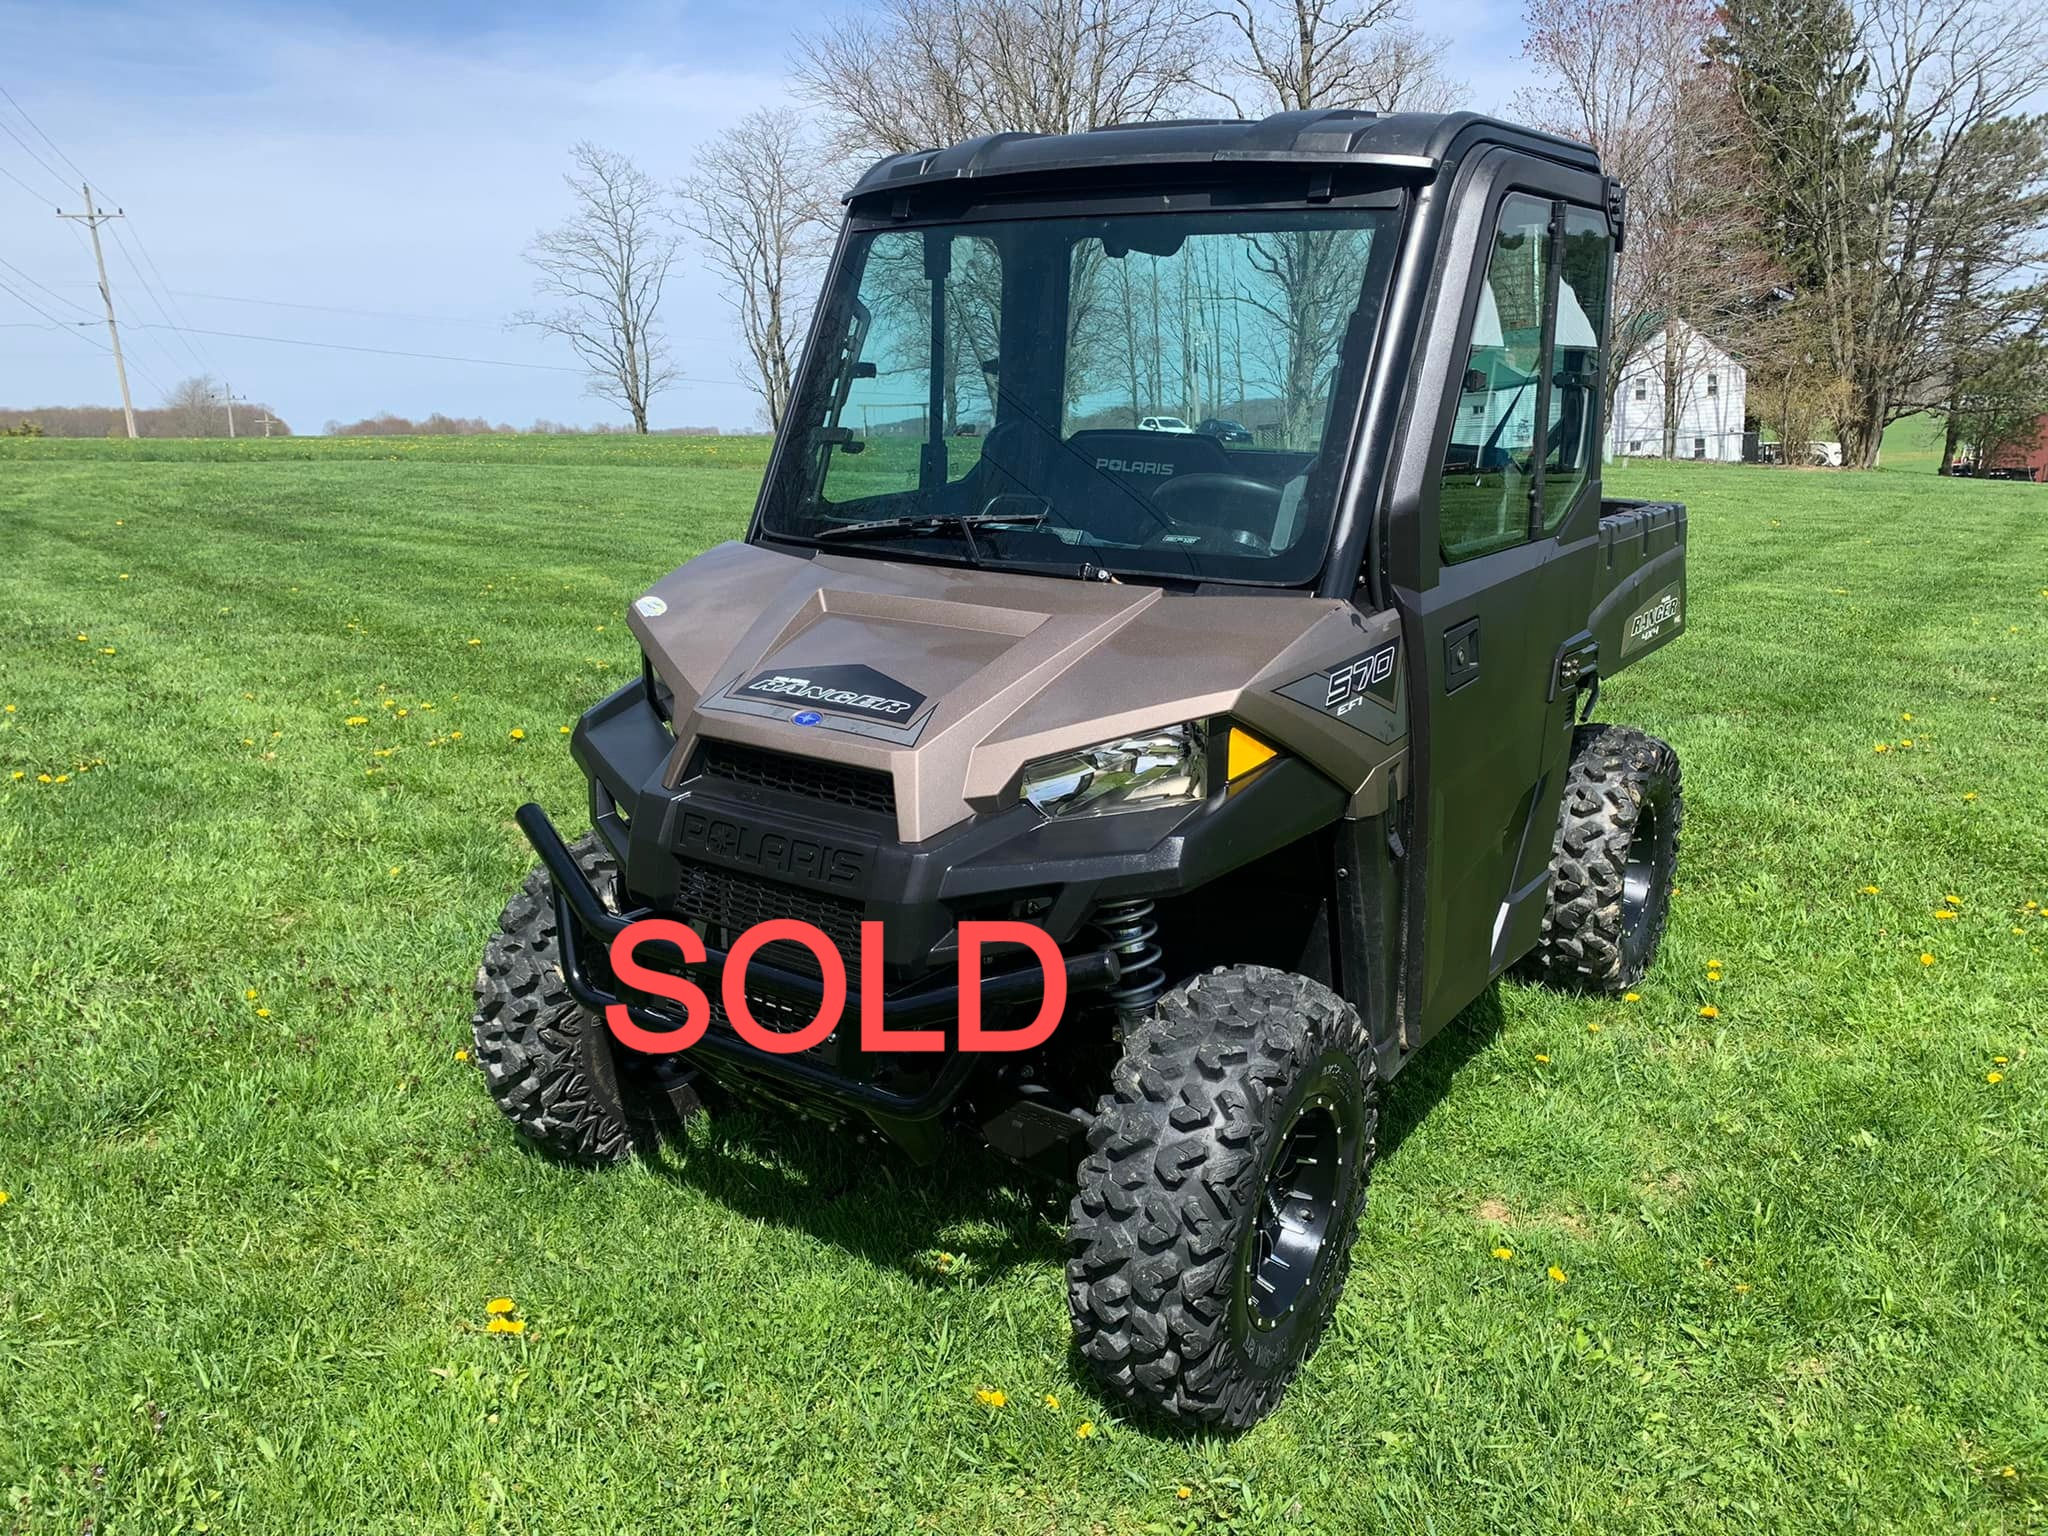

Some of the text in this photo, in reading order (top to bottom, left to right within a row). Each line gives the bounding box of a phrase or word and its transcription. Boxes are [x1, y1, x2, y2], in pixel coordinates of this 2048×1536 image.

[1096, 458, 1174, 475] POLARIS
[1631, 597, 1679, 637] RANGER
[1326, 646, 1395, 707] 570
[749, 678, 911, 715] RANGER
[1336, 695, 1363, 716] EFI
[679, 811, 867, 886] POLARIS
